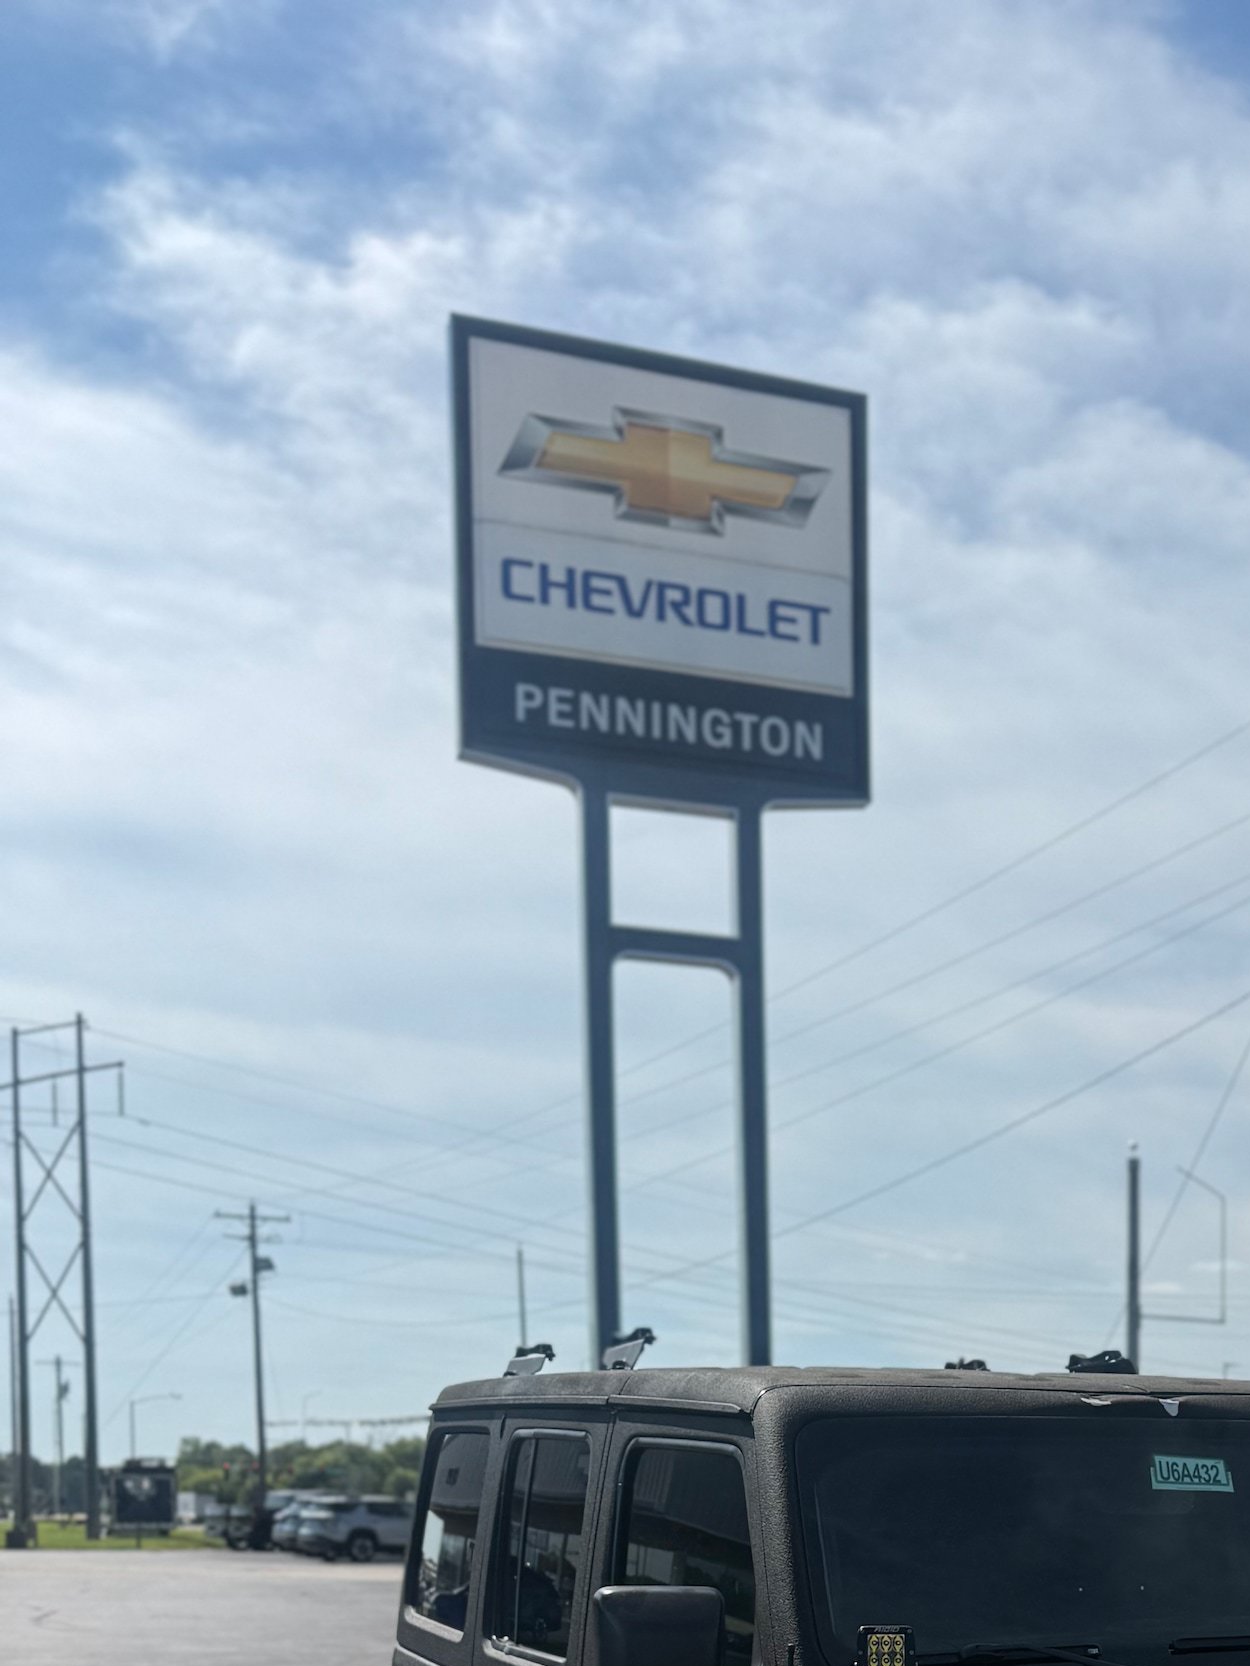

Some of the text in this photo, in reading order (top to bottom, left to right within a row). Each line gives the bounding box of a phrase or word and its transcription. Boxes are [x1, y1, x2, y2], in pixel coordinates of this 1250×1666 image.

[501, 558, 831, 645] CHEVROLET
[515, 683, 823, 760] PENNINGTON
[1158, 1461, 1222, 1484] U6A432
